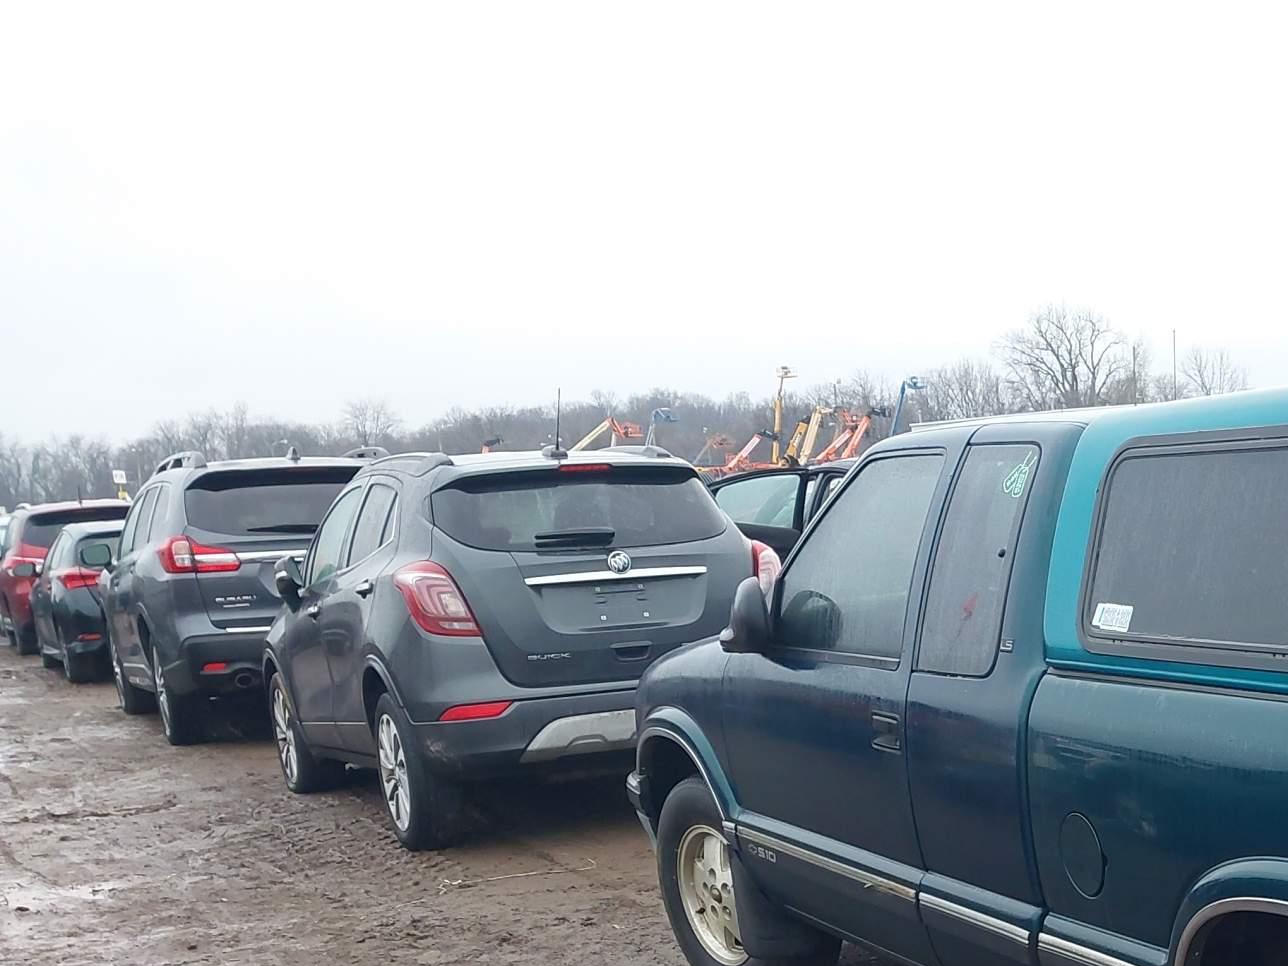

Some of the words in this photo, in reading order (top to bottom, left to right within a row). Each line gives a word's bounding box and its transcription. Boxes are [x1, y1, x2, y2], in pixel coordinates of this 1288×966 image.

[1000, 640, 1013, 650] LS
[527, 652, 572, 661] BUICK
[757, 846, 777, 864] S10
